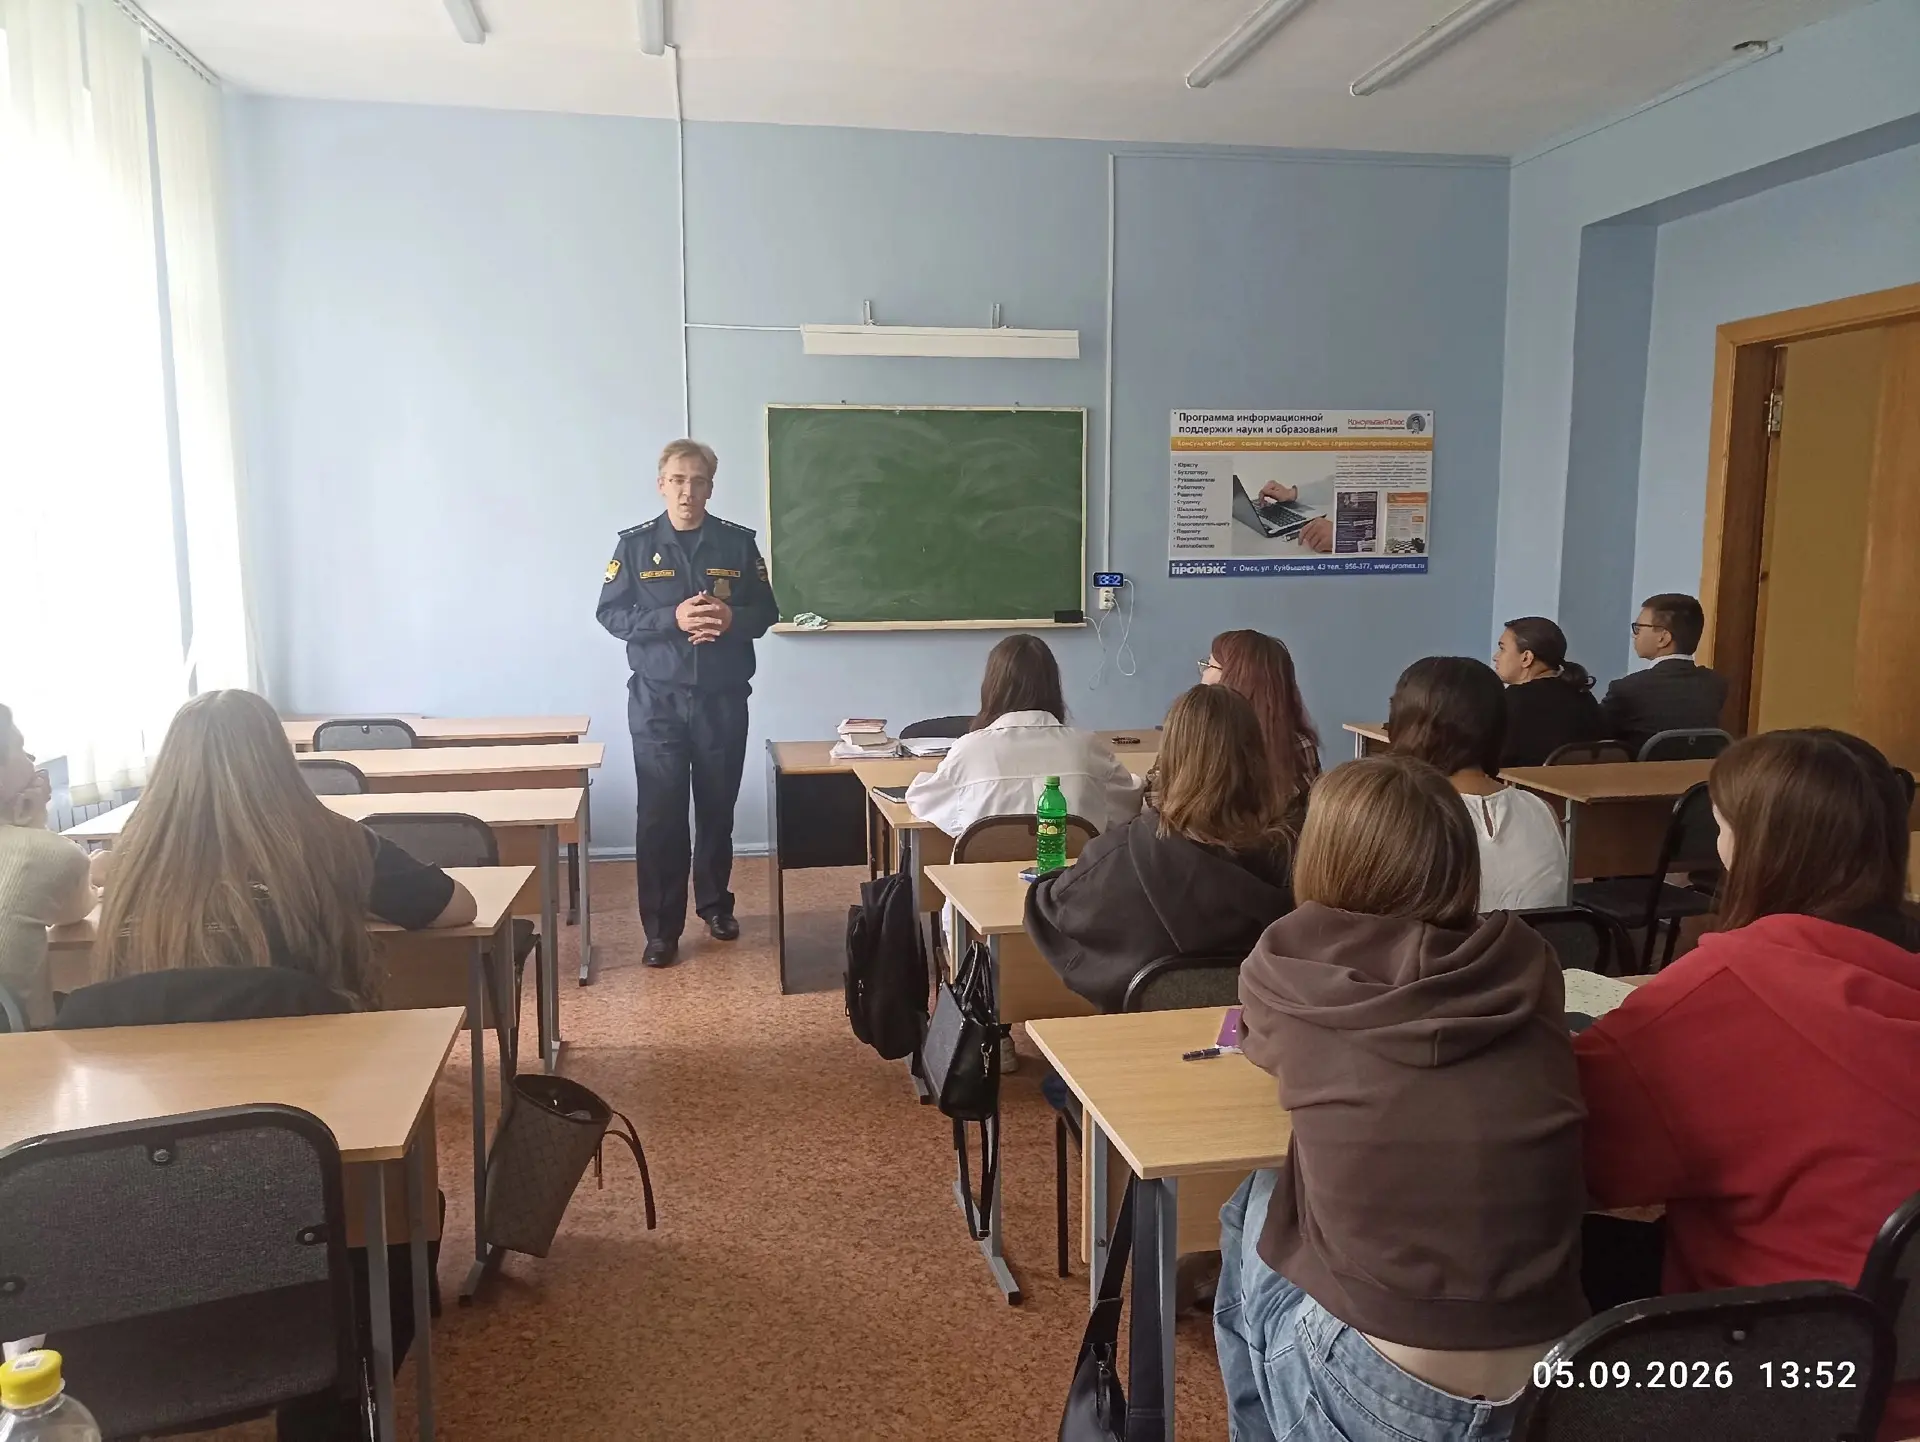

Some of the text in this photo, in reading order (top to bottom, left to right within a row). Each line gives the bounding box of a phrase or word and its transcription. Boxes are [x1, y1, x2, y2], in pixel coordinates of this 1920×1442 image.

[1179, 412, 1323, 423] Программа информационной
[1179, 425, 1233, 435] поддержки
[1236, 426, 1264, 436] науки
[1275, 424, 1338, 435] образования
[1171, 566, 1227, 575] ПРОМЭКС
[1239, 564, 1260, 573] Омск,
